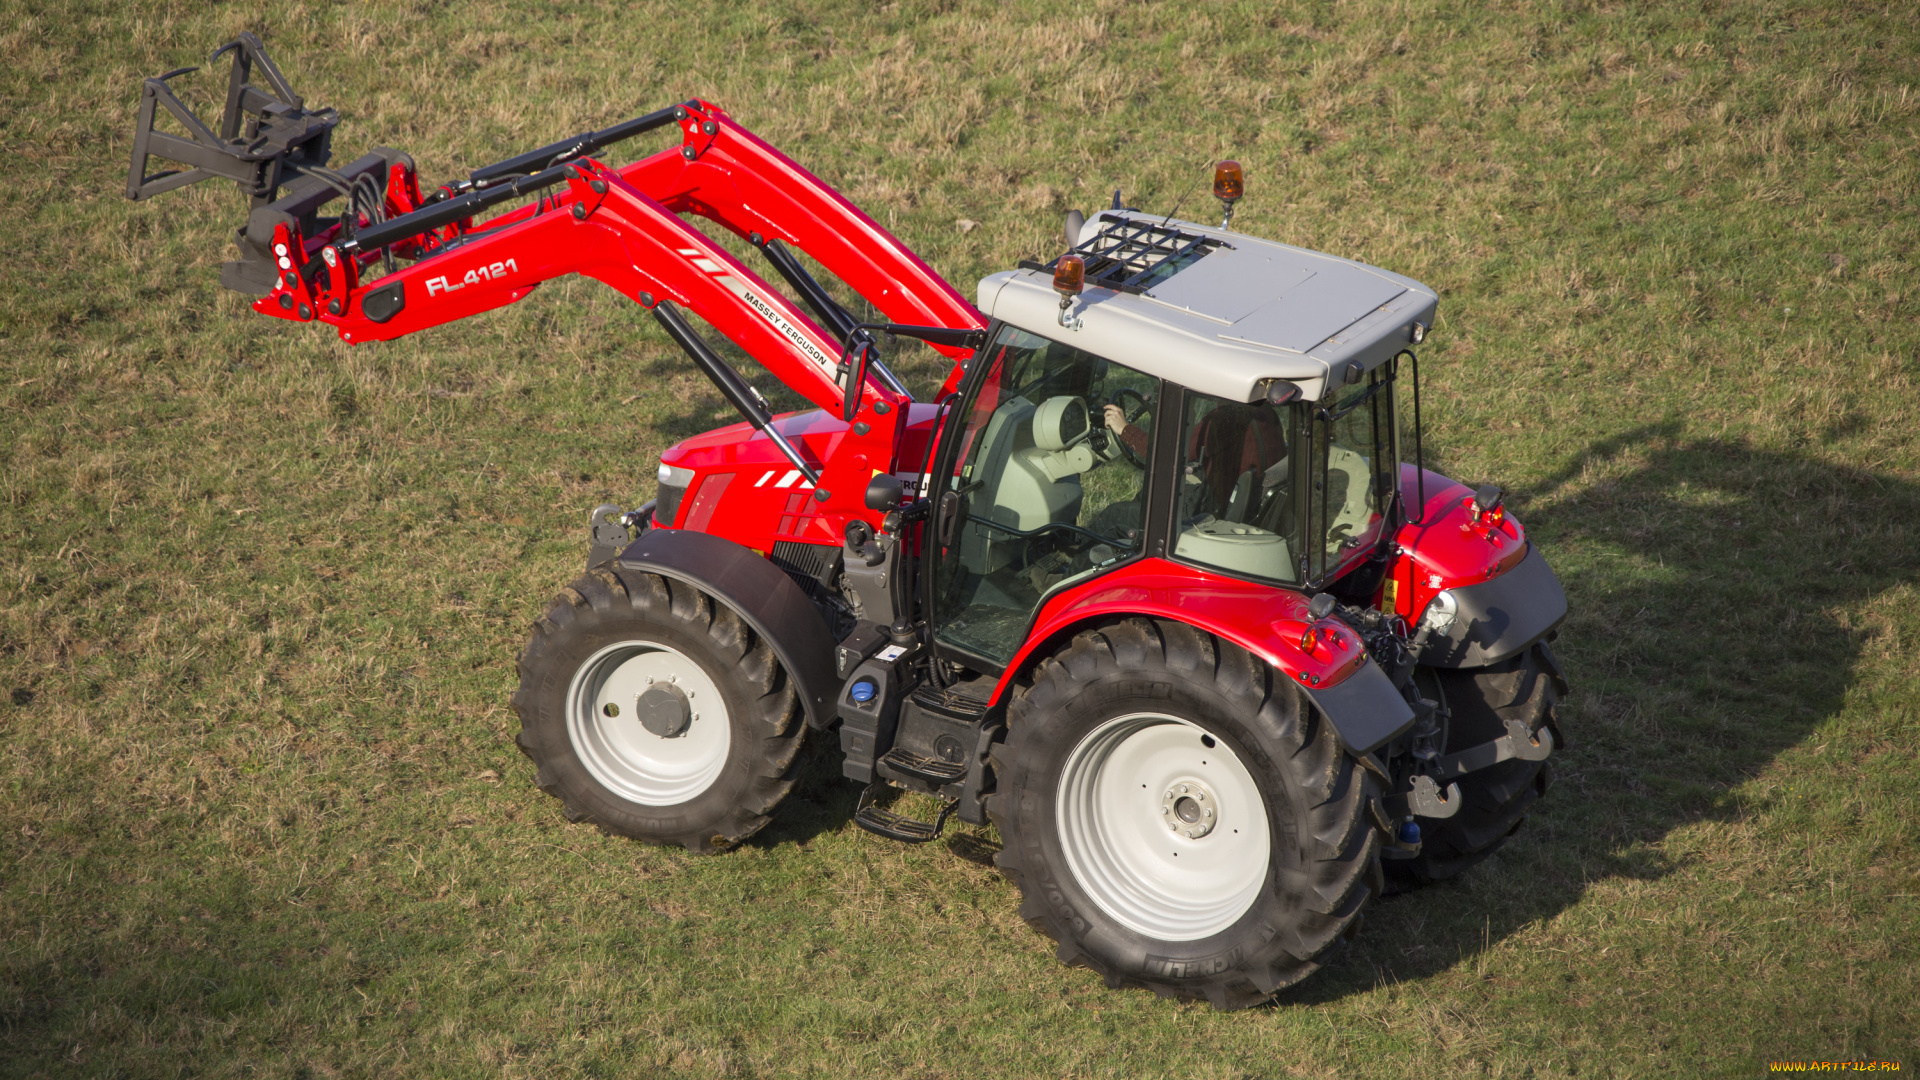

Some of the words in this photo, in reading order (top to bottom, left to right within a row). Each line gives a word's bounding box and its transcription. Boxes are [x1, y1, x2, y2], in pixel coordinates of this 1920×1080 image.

[425, 258, 518, 297] FL.4121
[744, 292, 781, 324] MASSEY
[781, 323, 827, 366] FERGUSON
